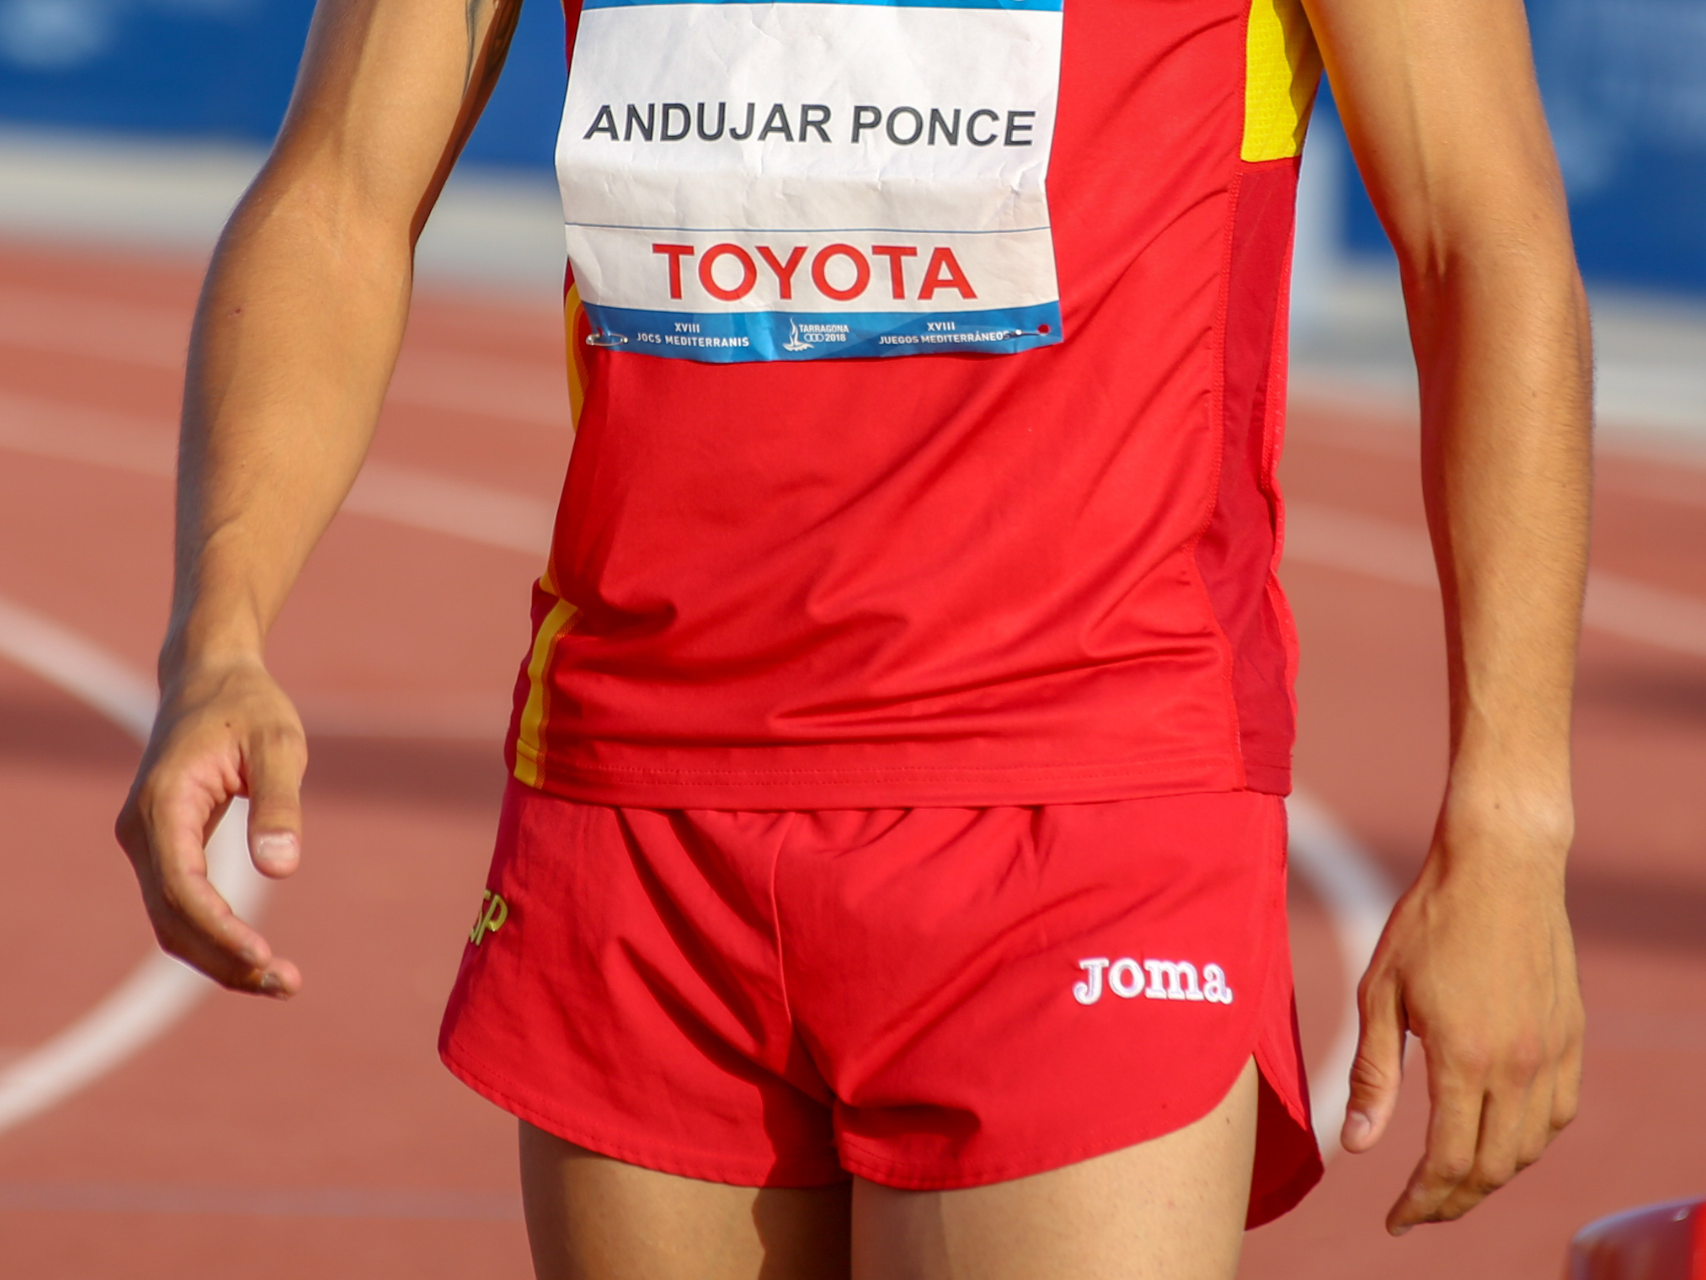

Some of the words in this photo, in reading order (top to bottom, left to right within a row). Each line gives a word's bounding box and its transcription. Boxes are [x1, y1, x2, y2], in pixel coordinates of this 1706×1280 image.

[583, 102, 832, 143] ANDUJAR
[851, 105, 1036, 147] PONCE
[652, 243, 978, 301] TOYOTA
[674, 322, 700, 333] XVIII
[799, 324, 850, 334] TARRAGONA
[926, 321, 956, 331] XVIII
[637, 332, 661, 344] JOCS
[664, 334, 750, 348] MEDITERRANIS
[825, 333, 847, 342] 2018
[878, 335, 919, 345] JUEGOS
[1073, 956, 1234, 1006] Joma
